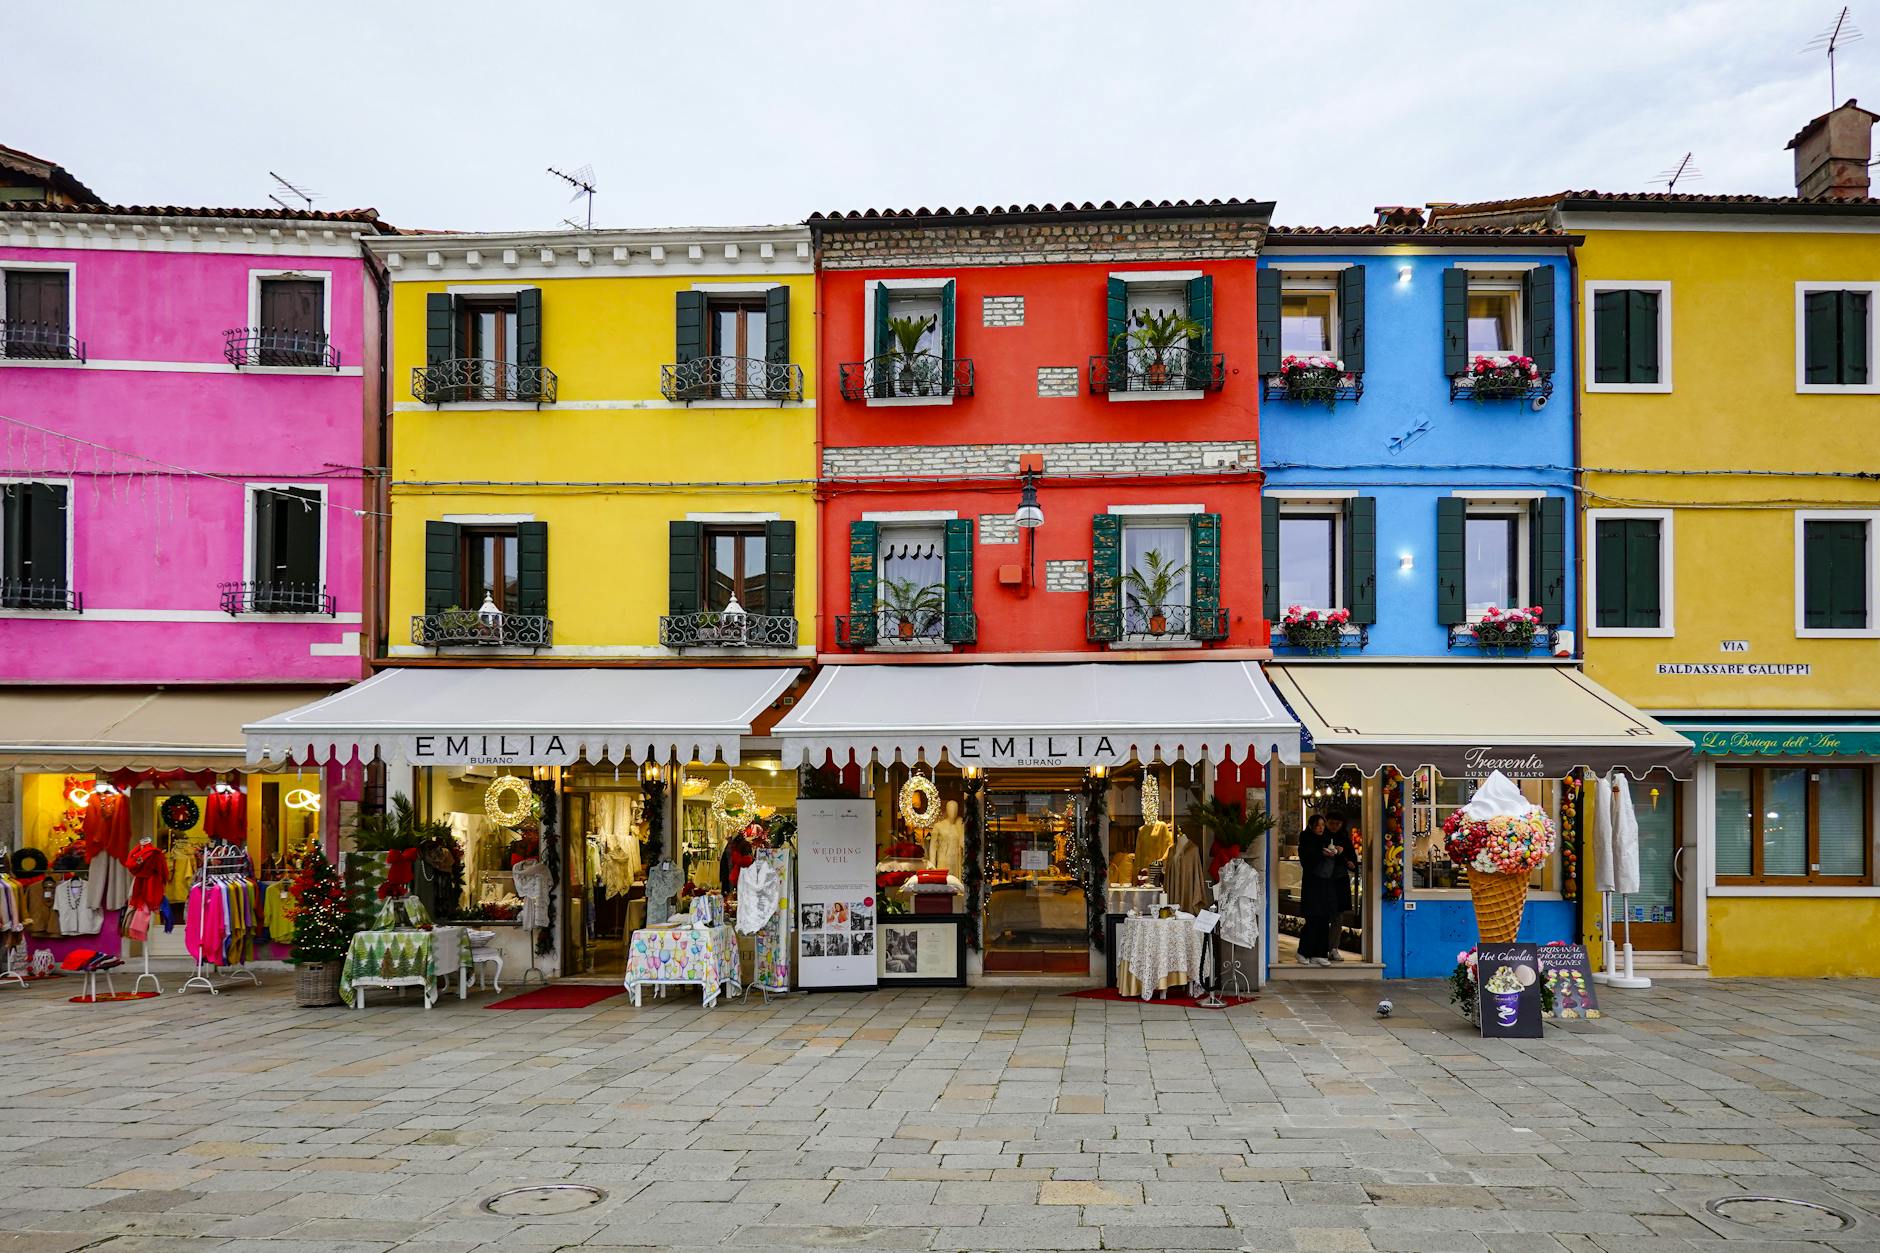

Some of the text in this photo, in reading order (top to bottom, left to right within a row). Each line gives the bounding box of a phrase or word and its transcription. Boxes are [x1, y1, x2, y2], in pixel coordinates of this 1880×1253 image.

[1723, 642, 1744, 651] VIA
[1658, 664, 1810, 675] BALDASSARE GALUPPI
[416, 735, 567, 756] EMILIA
[960, 736, 1117, 758] EMILIA
[1701, 731, 1726, 748] La
[1730, 731, 1778, 753] Bottega
[1808, 732, 1841, 748] Arte
[1464, 746, 1542, 769] Trexento
[812, 847, 862, 855] WEDDING
[825, 856, 848, 864] VEIL
[1479, 948, 1534, 961] Hot Chocolate
